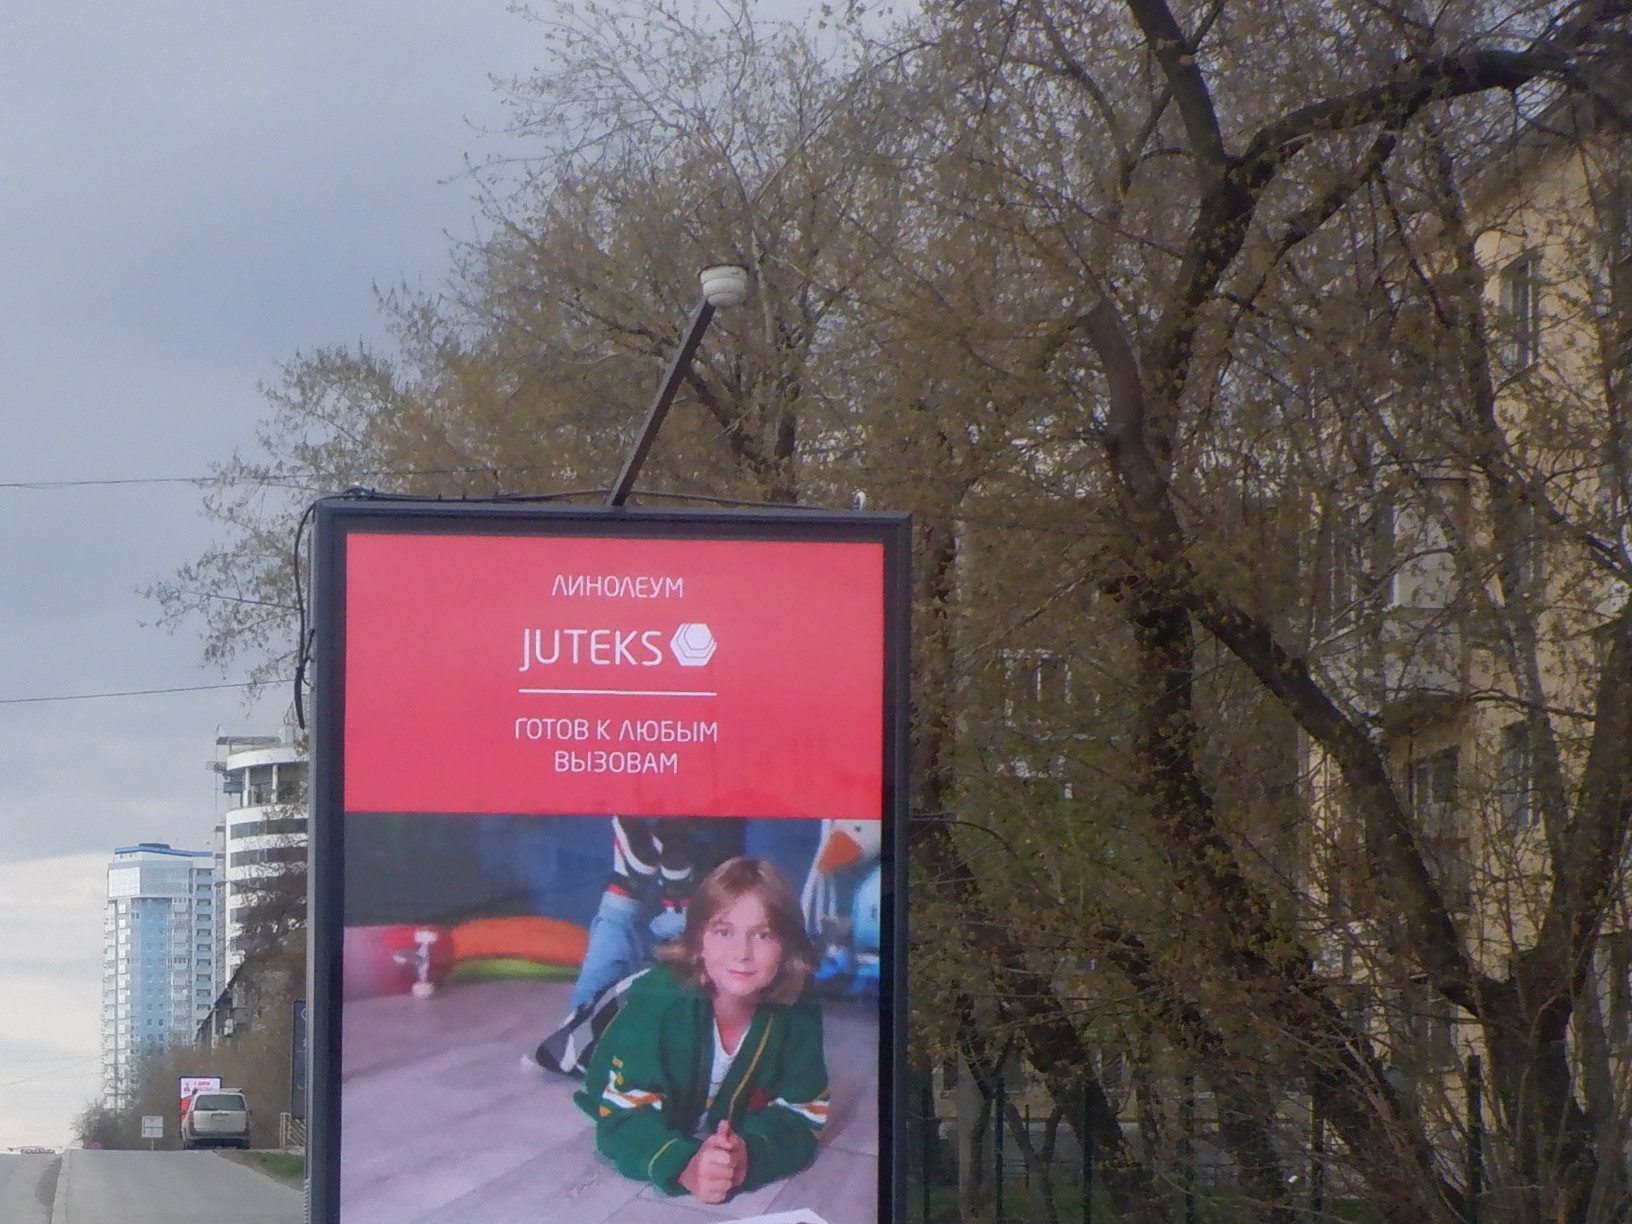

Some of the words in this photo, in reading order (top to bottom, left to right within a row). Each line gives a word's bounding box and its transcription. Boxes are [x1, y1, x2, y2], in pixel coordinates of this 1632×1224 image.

[551, 574, 684, 599] ЛИНОЛЕУМ
[518, 627, 664, 673] JUTEKS
[514, 717, 590, 741] ГОТОВ
[596, 718, 612, 742] К
[618, 719, 719, 743] ЛЮБЫМ
[553, 750, 679, 775] ВЫЗОВАМ
